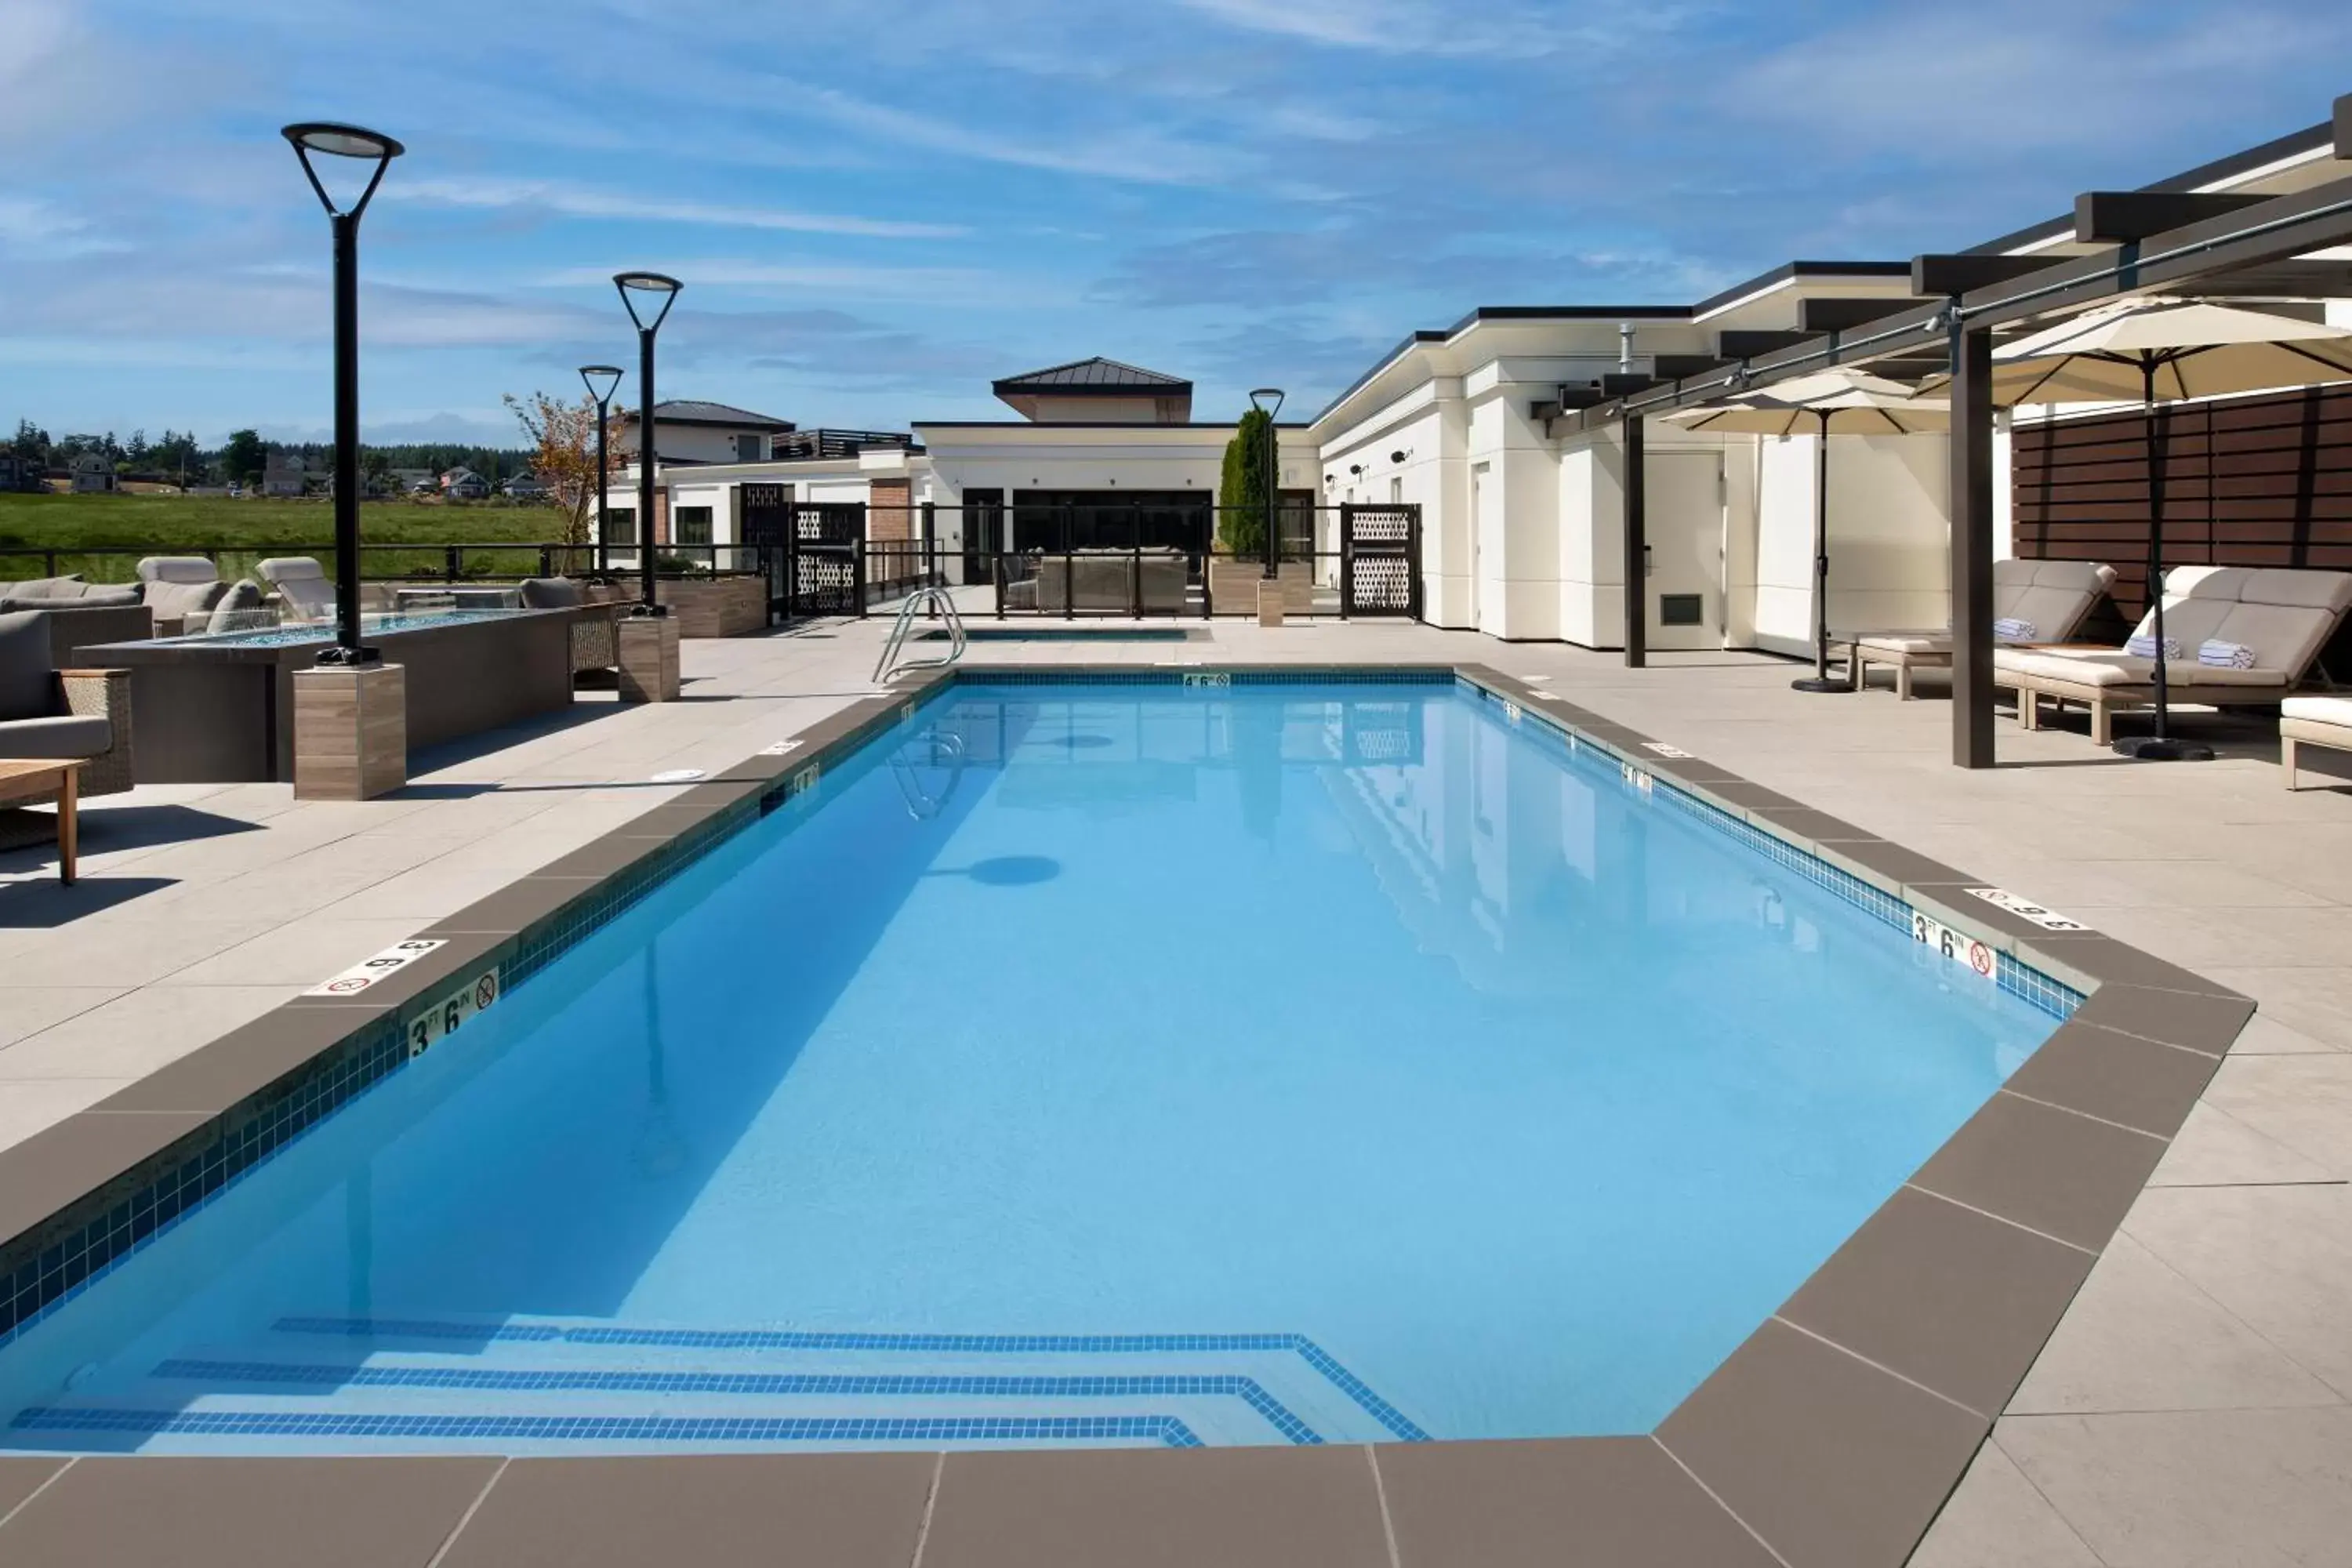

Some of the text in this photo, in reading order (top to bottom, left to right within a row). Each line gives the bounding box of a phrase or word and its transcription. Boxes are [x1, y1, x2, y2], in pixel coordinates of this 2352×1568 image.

[1185, 675, 1192, 685] 4
[1915, 916, 1927, 943] 3
[1941, 929, 1954, 959] 6
[412, 990, 470, 1058] 3 FT 6 IN
